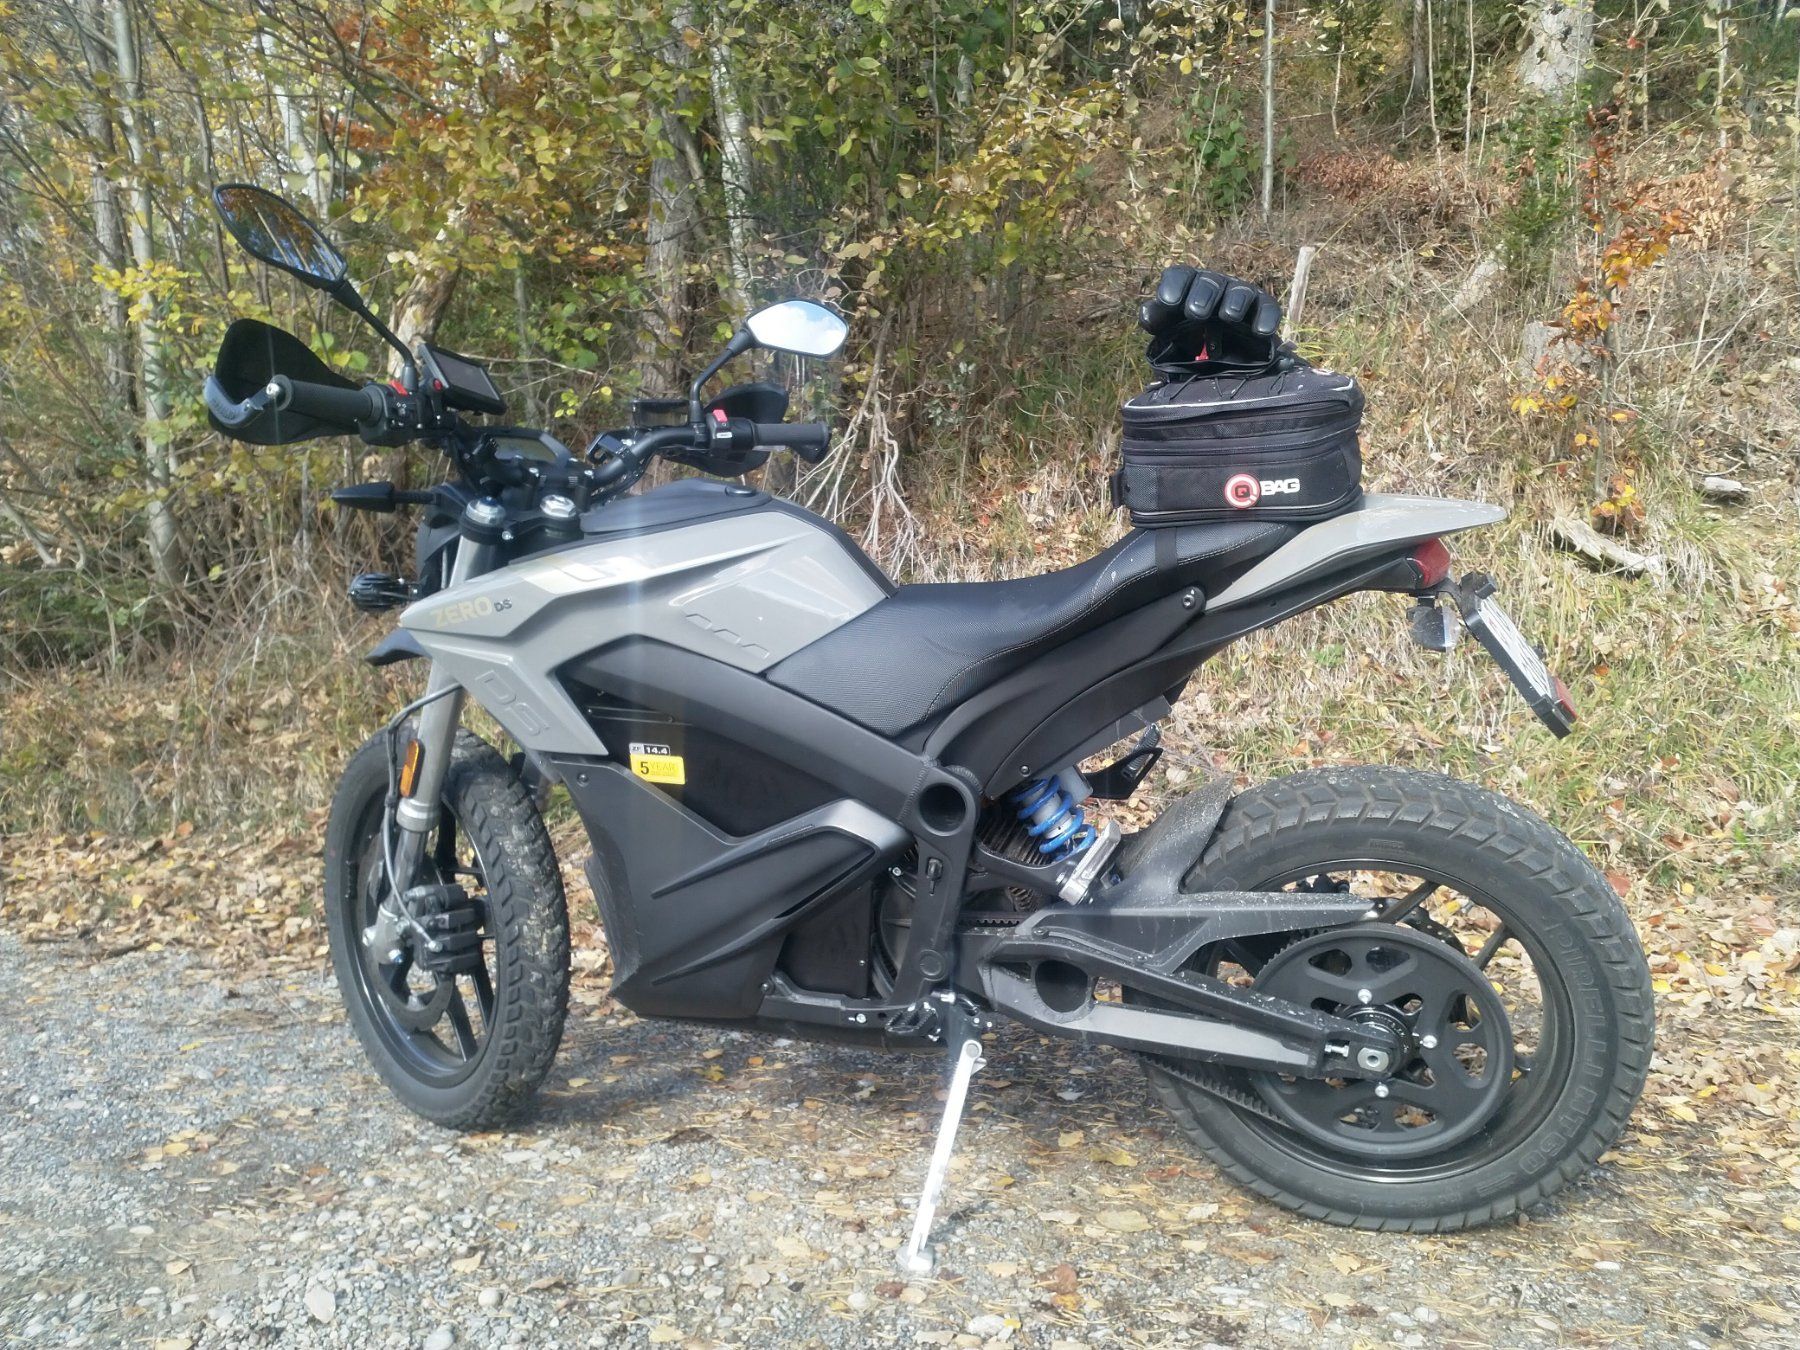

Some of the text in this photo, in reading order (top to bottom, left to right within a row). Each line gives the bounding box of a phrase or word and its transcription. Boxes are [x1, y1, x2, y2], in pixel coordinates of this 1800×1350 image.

[429, 596, 513, 628] ZERO DS
[645, 746, 668, 755] 14.4
[640, 761, 650, 775] 5
[1557, 931, 1607, 1078] PIRELLI
